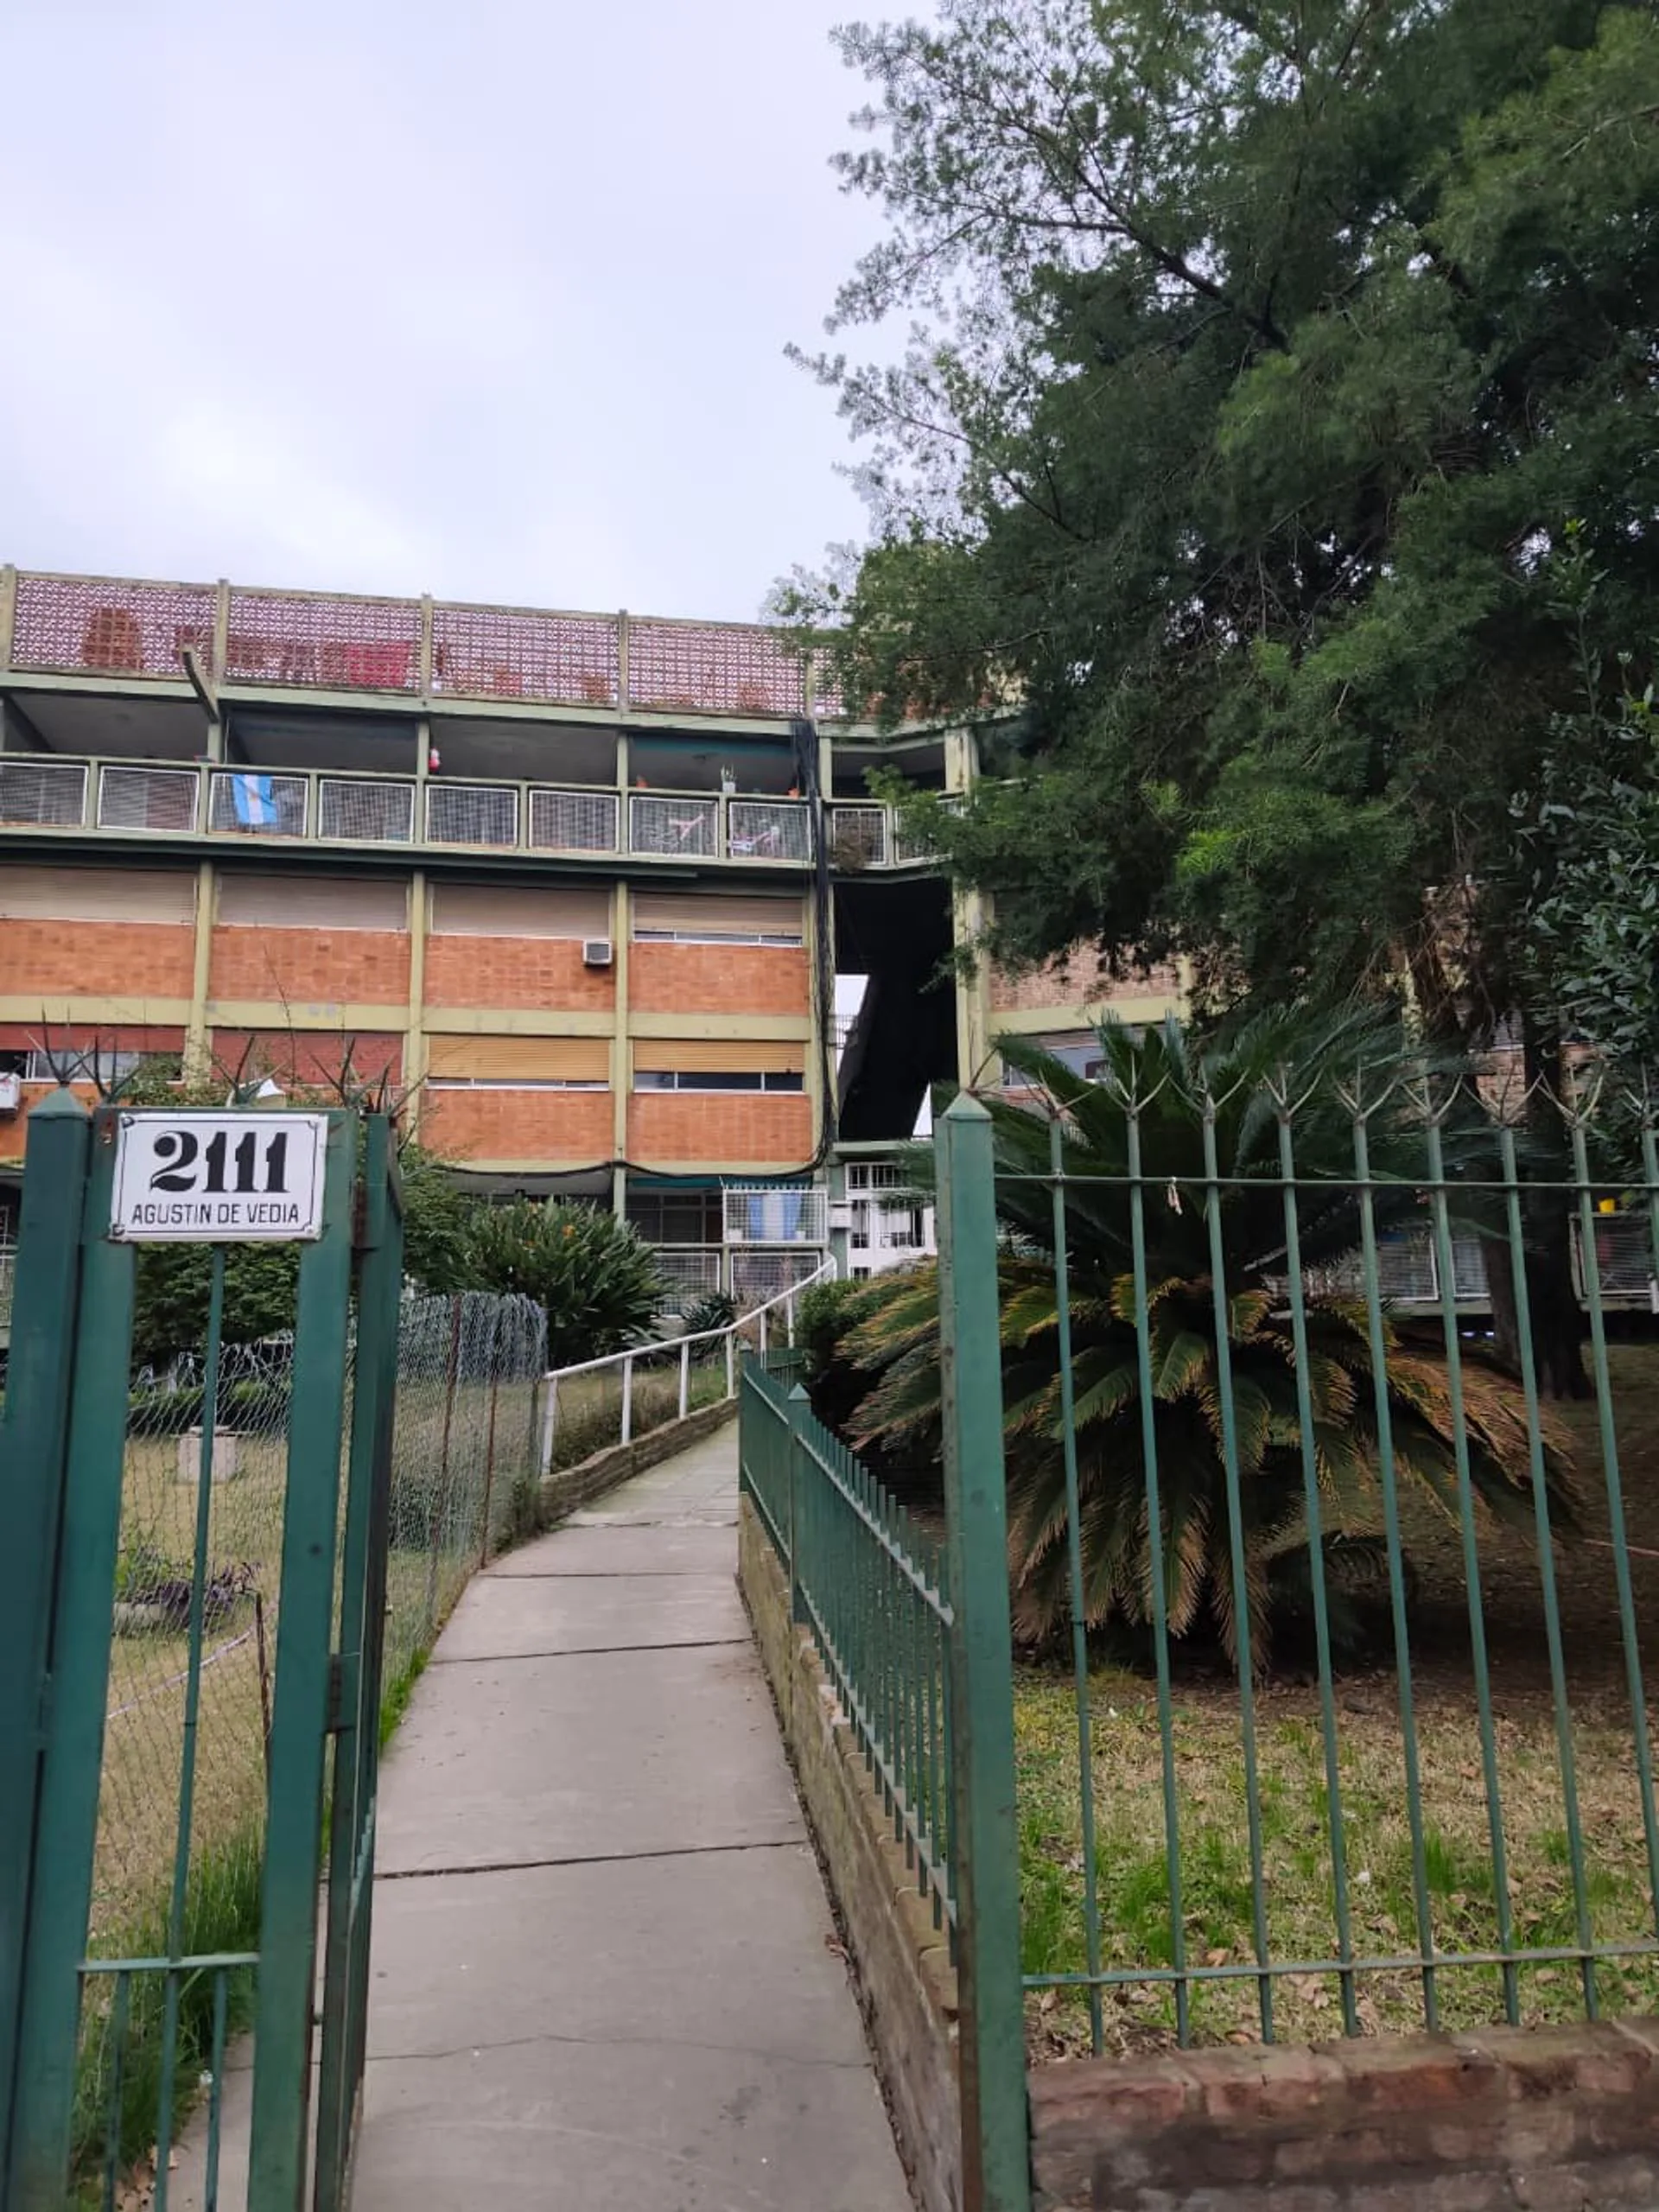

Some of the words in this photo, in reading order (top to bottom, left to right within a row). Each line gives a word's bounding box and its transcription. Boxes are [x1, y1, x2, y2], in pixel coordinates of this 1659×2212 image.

[149, 1130, 290, 1193] 2111
[131, 1203, 212, 1224] AGUSTIN
[217, 1203, 242, 1224] DE
[247, 1203, 299, 1224] VEDIA
